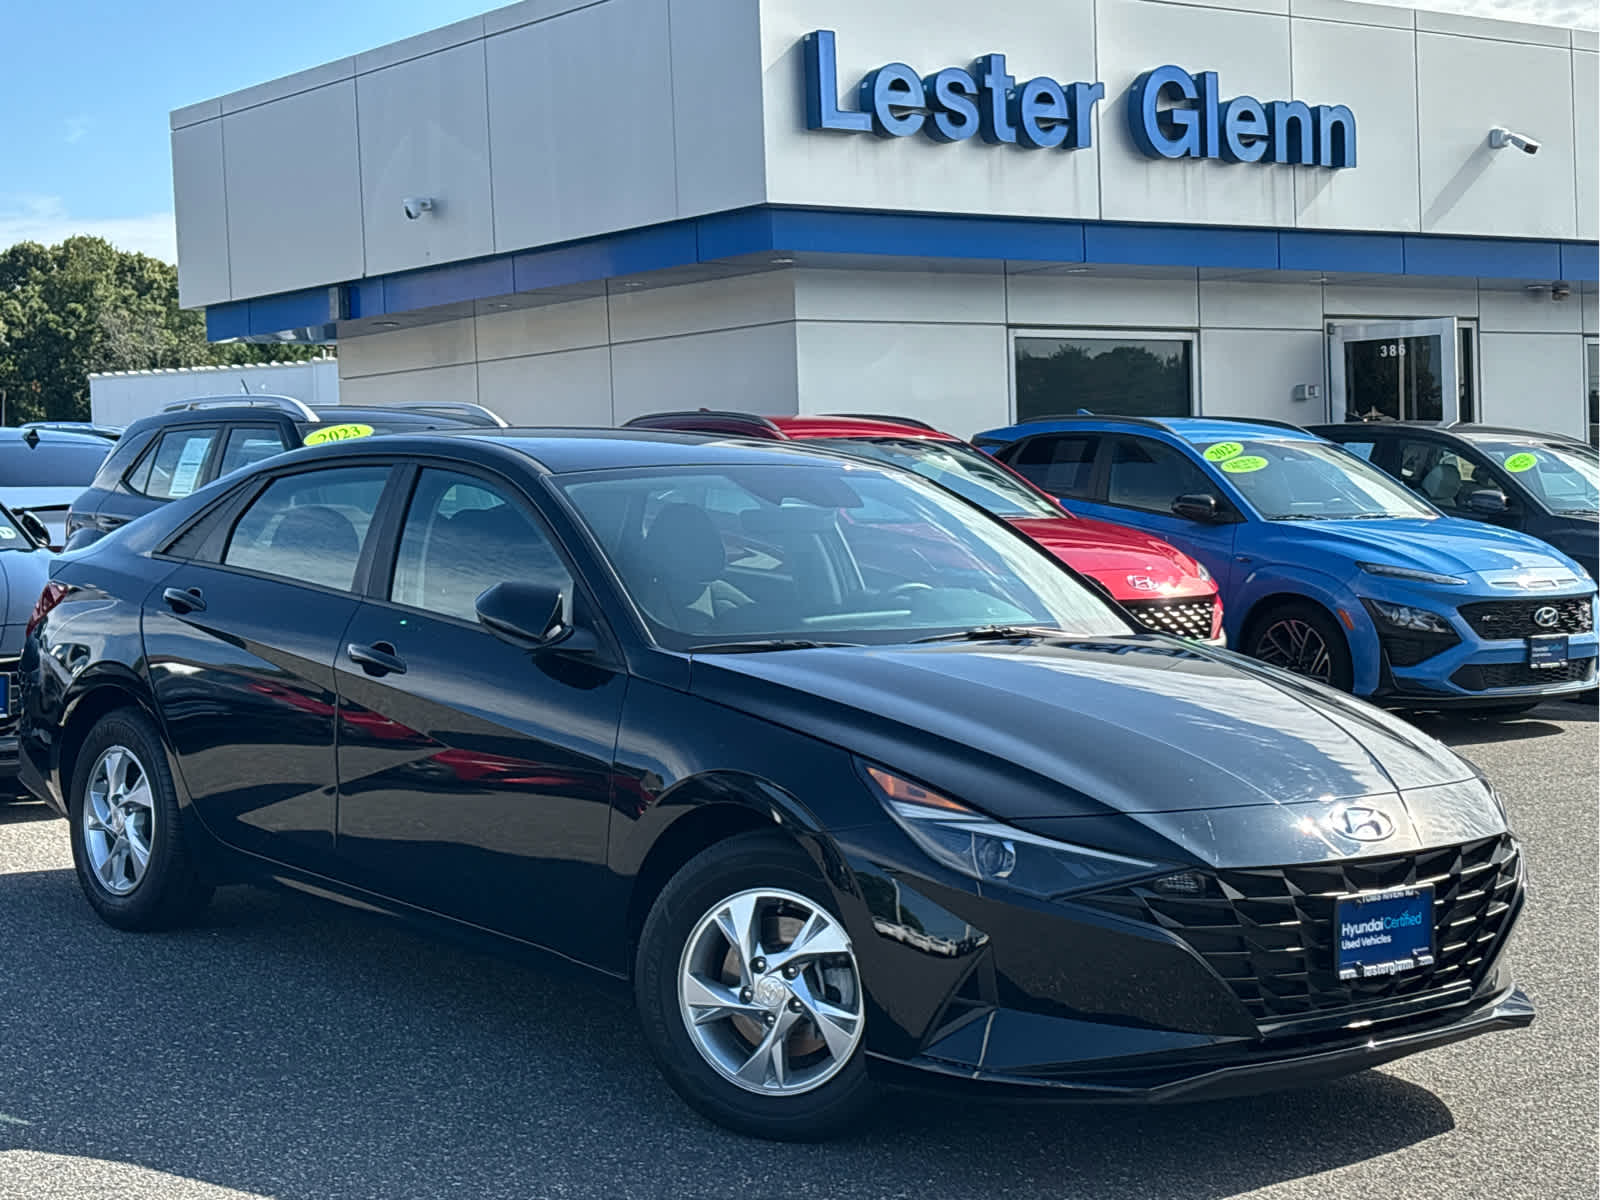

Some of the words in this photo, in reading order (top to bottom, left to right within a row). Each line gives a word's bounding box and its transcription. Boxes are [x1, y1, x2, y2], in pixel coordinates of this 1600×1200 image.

[804, 30, 1104, 149] Lester
[1129, 64, 1357, 169] Glenn
[1380, 344, 1406, 357] 386
[318, 426, 361, 442] 2023
[1209, 443, 1238, 459] 2022
[1341, 937, 1360, 950] Used
[1361, 934, 1392, 947] Vehicles
